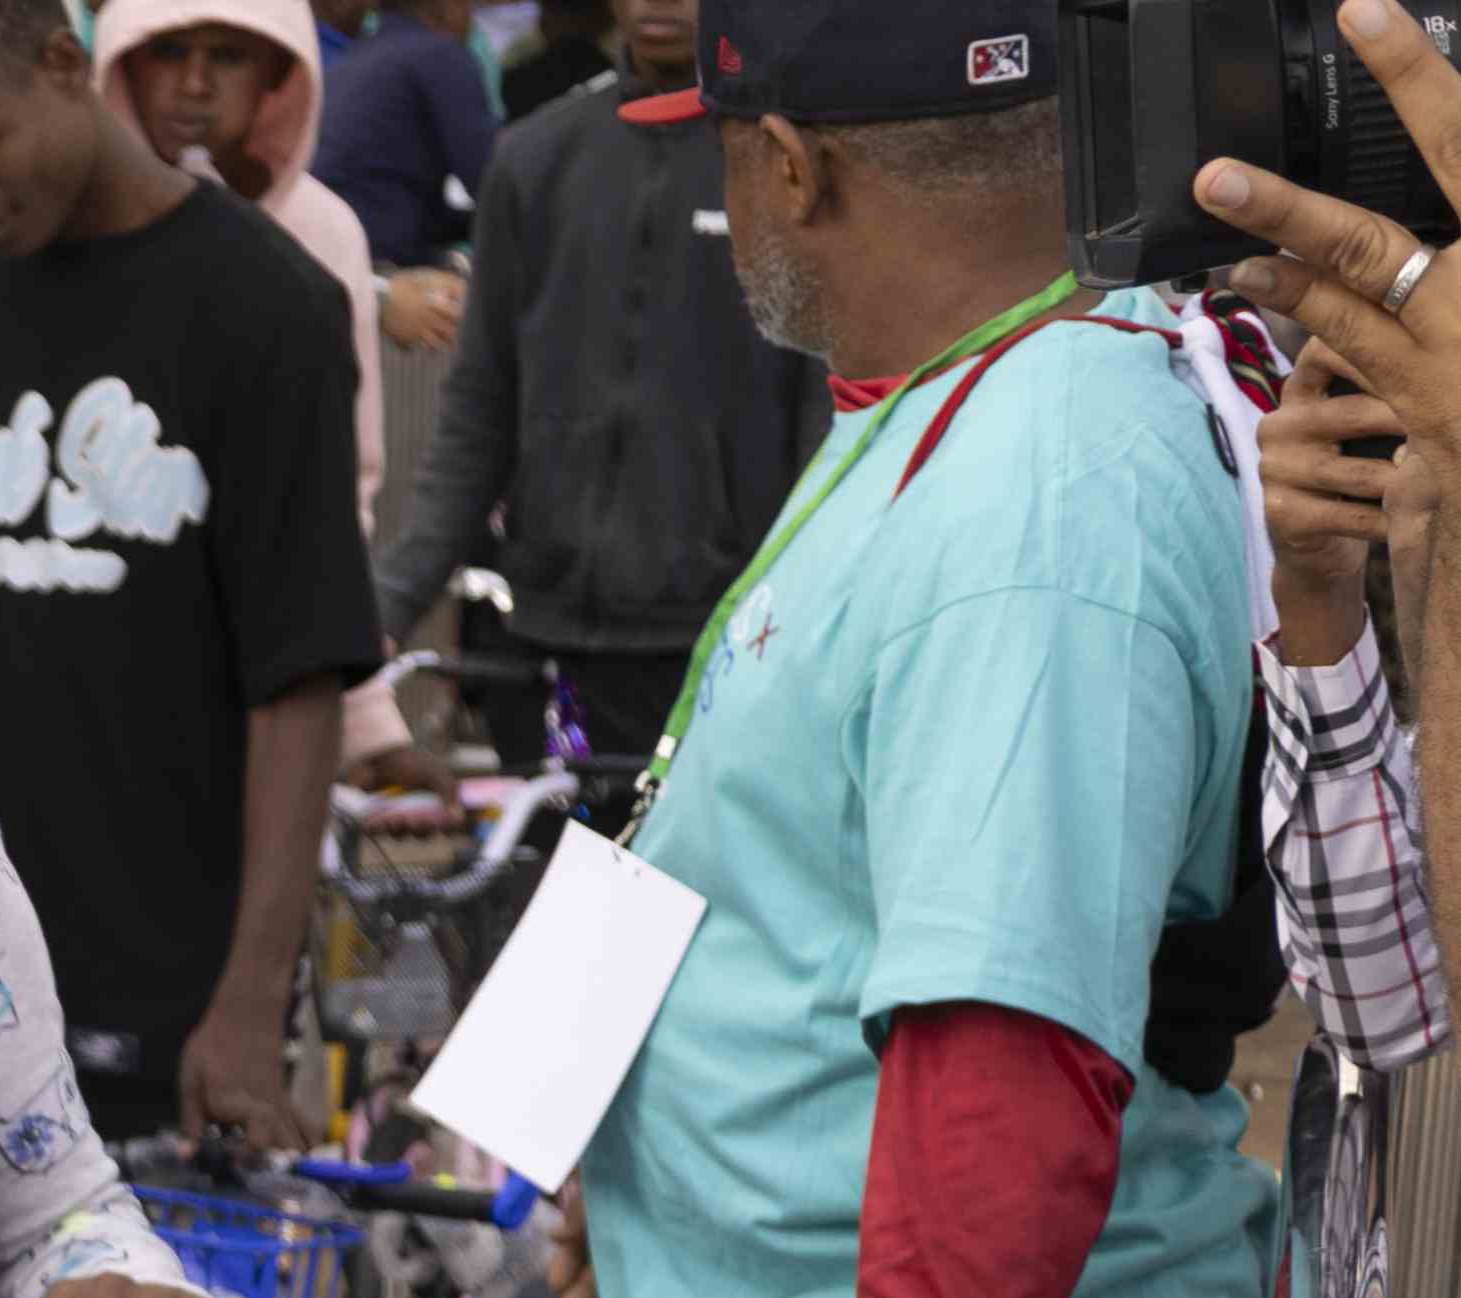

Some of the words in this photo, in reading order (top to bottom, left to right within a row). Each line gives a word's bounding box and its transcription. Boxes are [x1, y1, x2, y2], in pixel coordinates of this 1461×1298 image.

[1321, 52, 1336, 65] G
[1322, 65, 1338, 97] Lens
[1325, 97, 1340, 130] Sony
